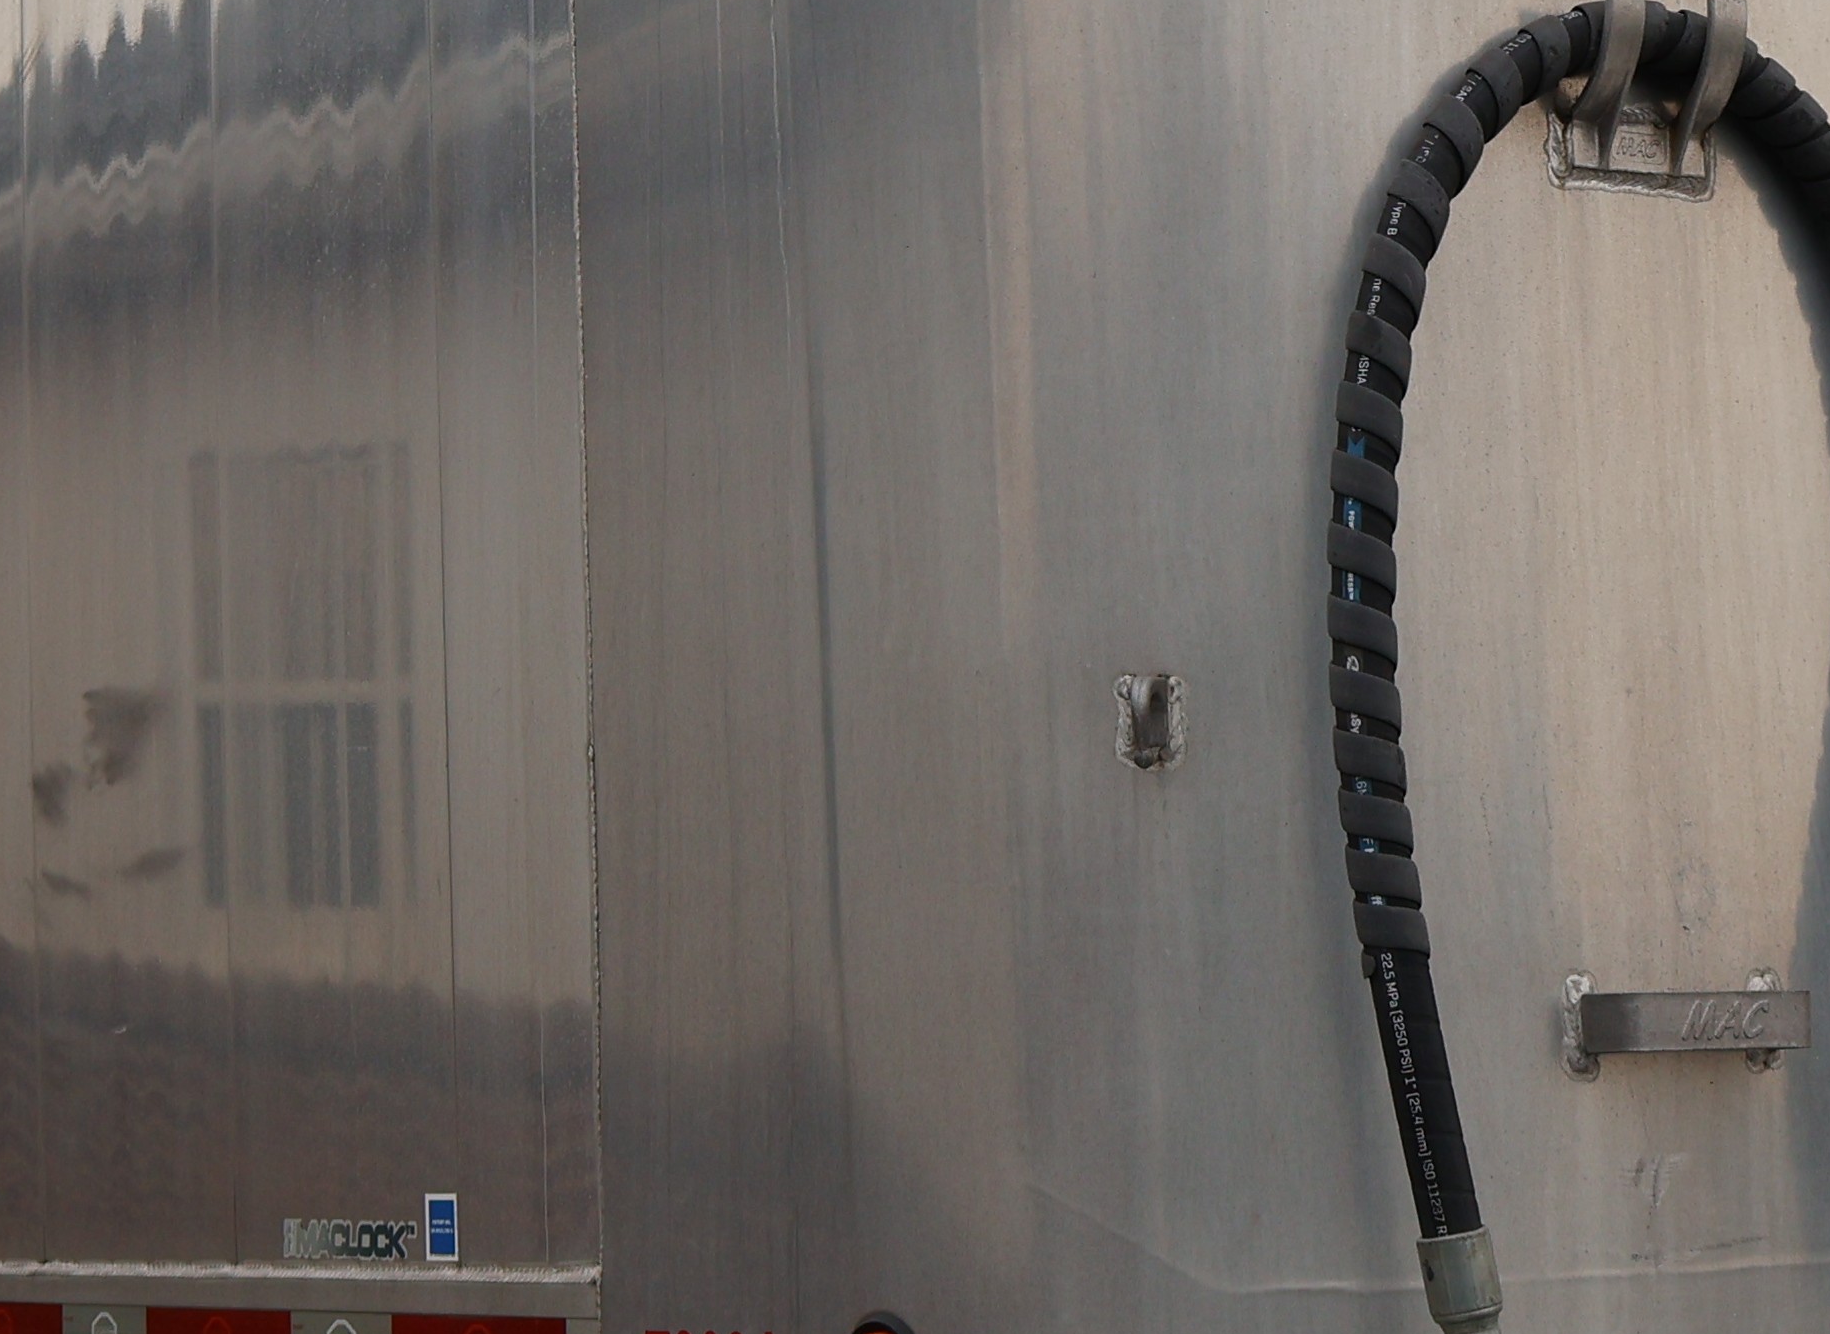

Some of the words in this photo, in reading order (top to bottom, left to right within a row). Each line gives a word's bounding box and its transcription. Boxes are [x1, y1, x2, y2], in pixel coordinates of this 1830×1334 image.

[1616, 136, 1660, 159] MAC
[1379, 951, 1396, 980] 22.5
[1384, 980, 1400, 1008] MPa
[1681, 999, 1771, 1041] MAC
[1421, 1158, 1436, 1180] ISO
[1426, 1182, 1446, 1222] 11237
